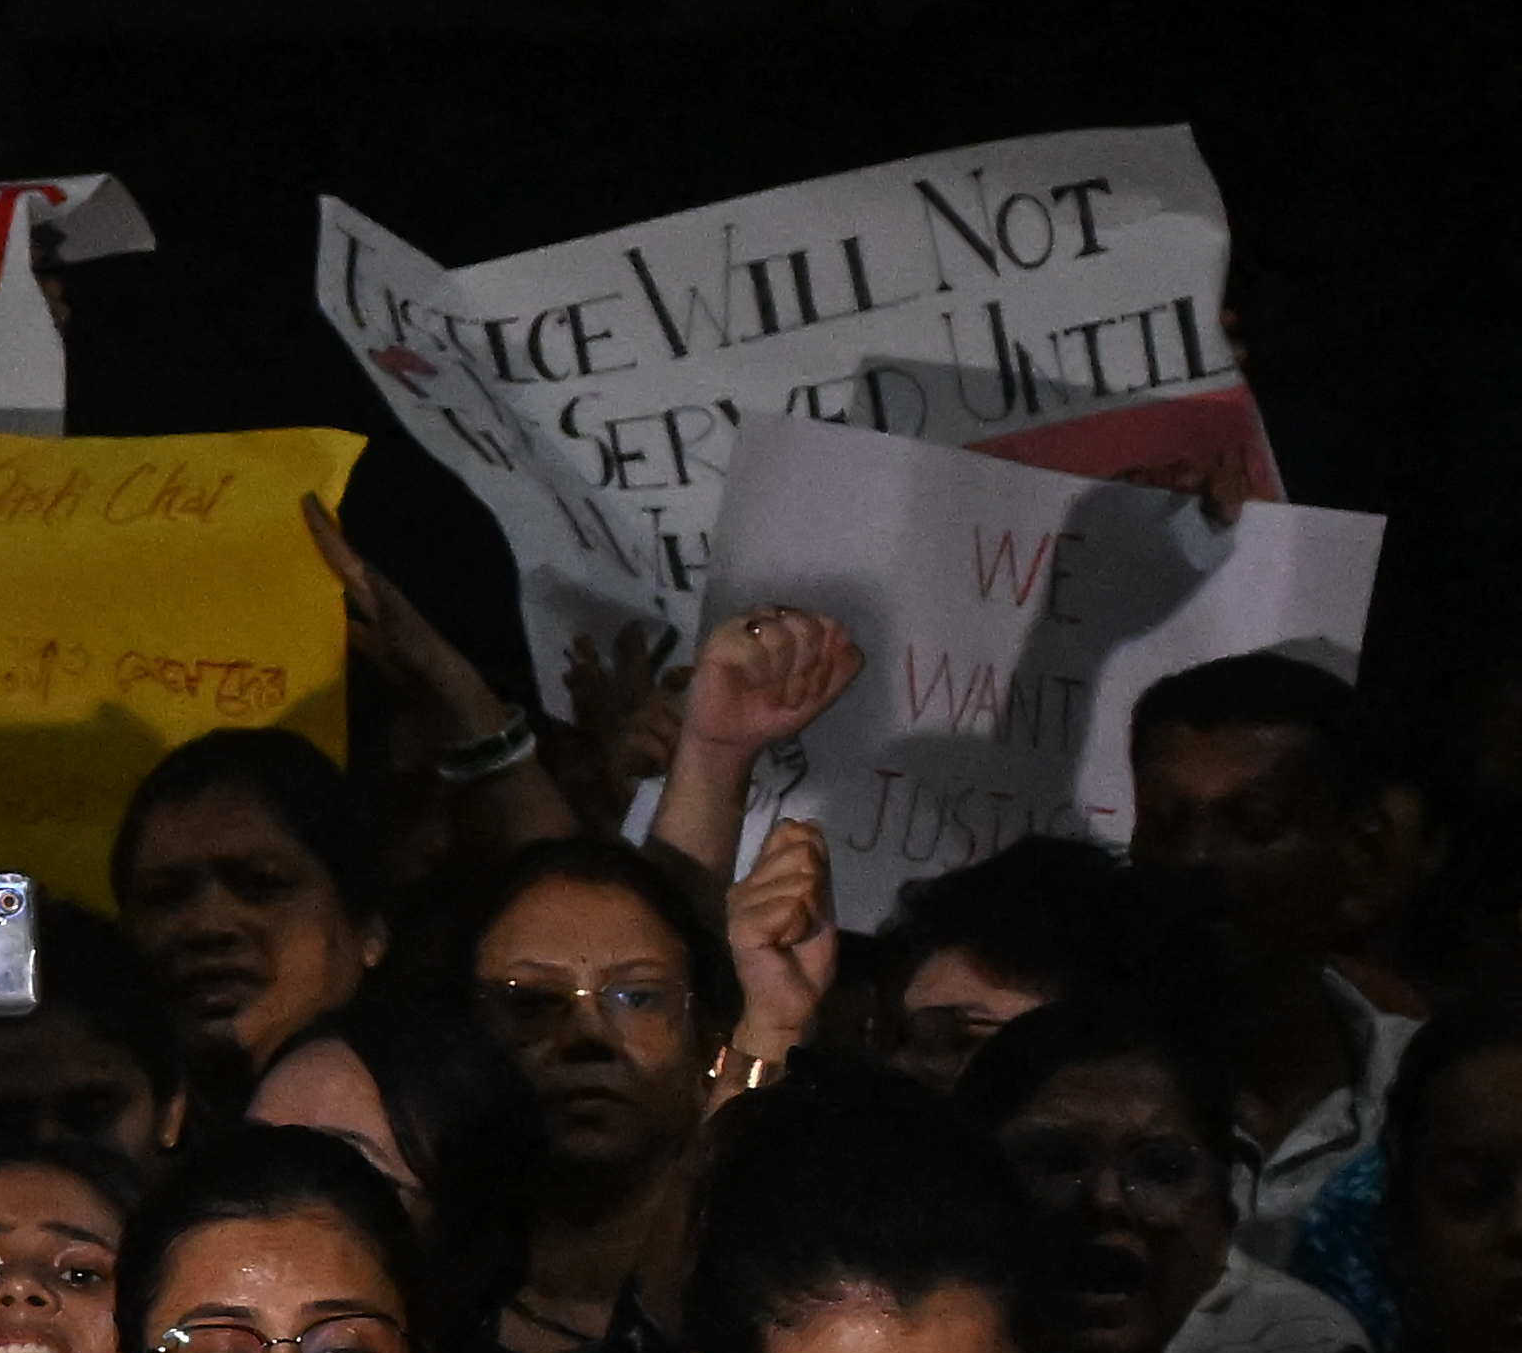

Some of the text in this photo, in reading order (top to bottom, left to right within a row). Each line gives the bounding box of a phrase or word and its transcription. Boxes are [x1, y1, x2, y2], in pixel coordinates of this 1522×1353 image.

[625, 223, 922, 360] WILL
[913, 166, 1113, 294] NOT
[940, 295, 1233, 425] UNTIL
[971, 523, 1086, 626] WE
[904, 645, 1086, 748] WANT
